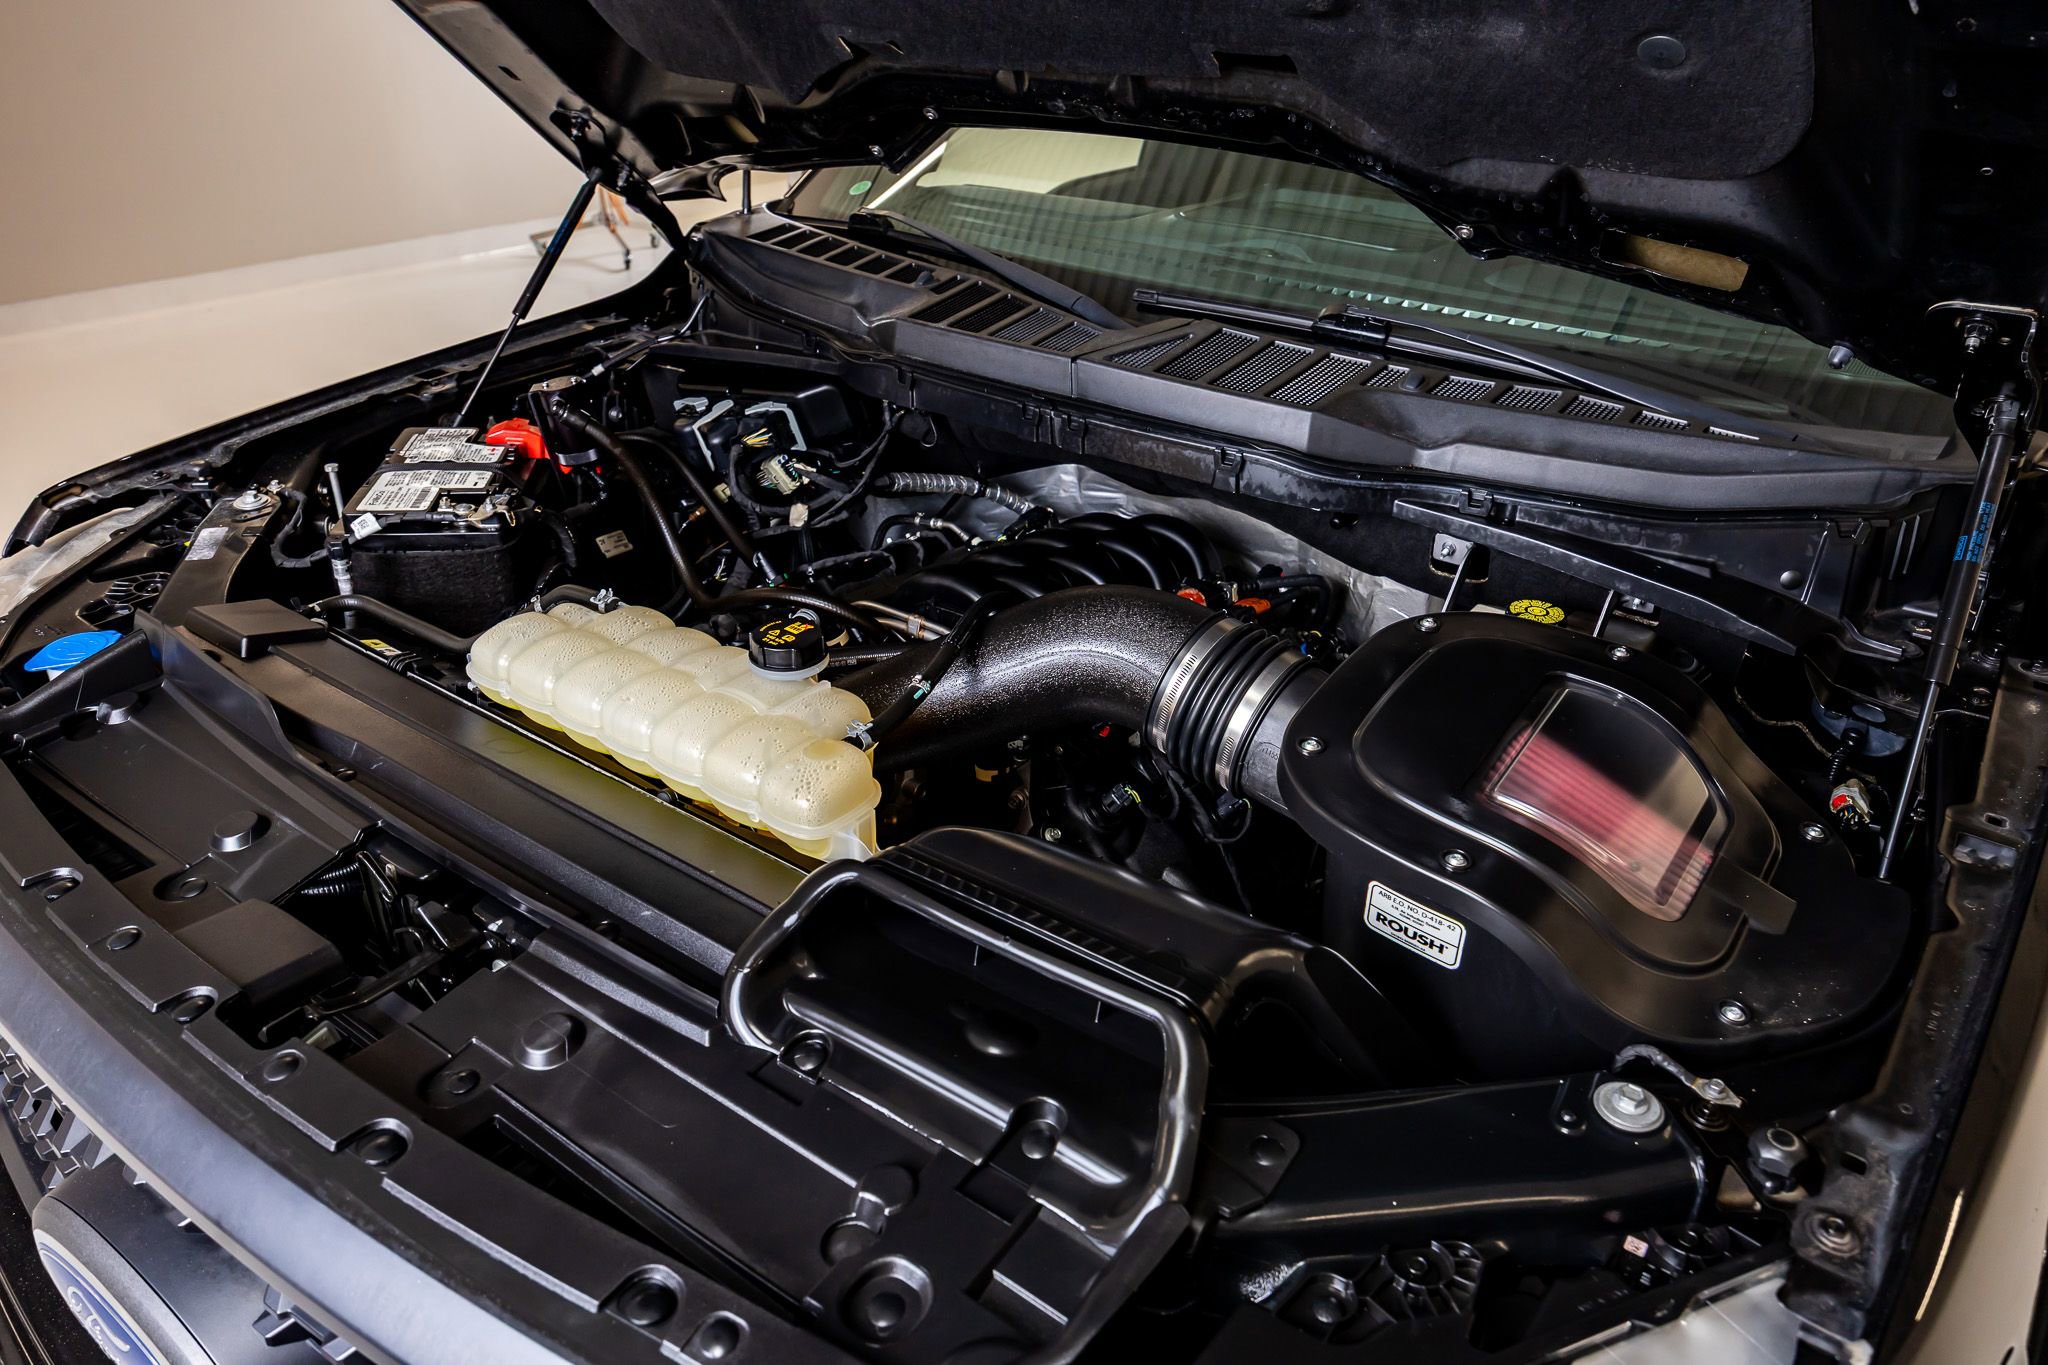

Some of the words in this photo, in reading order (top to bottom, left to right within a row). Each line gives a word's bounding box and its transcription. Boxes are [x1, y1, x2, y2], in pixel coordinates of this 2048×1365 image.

[1378, 890, 1392, 901] ARB
[1407, 905, 1421, 916] NO.
[1375, 912, 1445, 954] ROUSH
